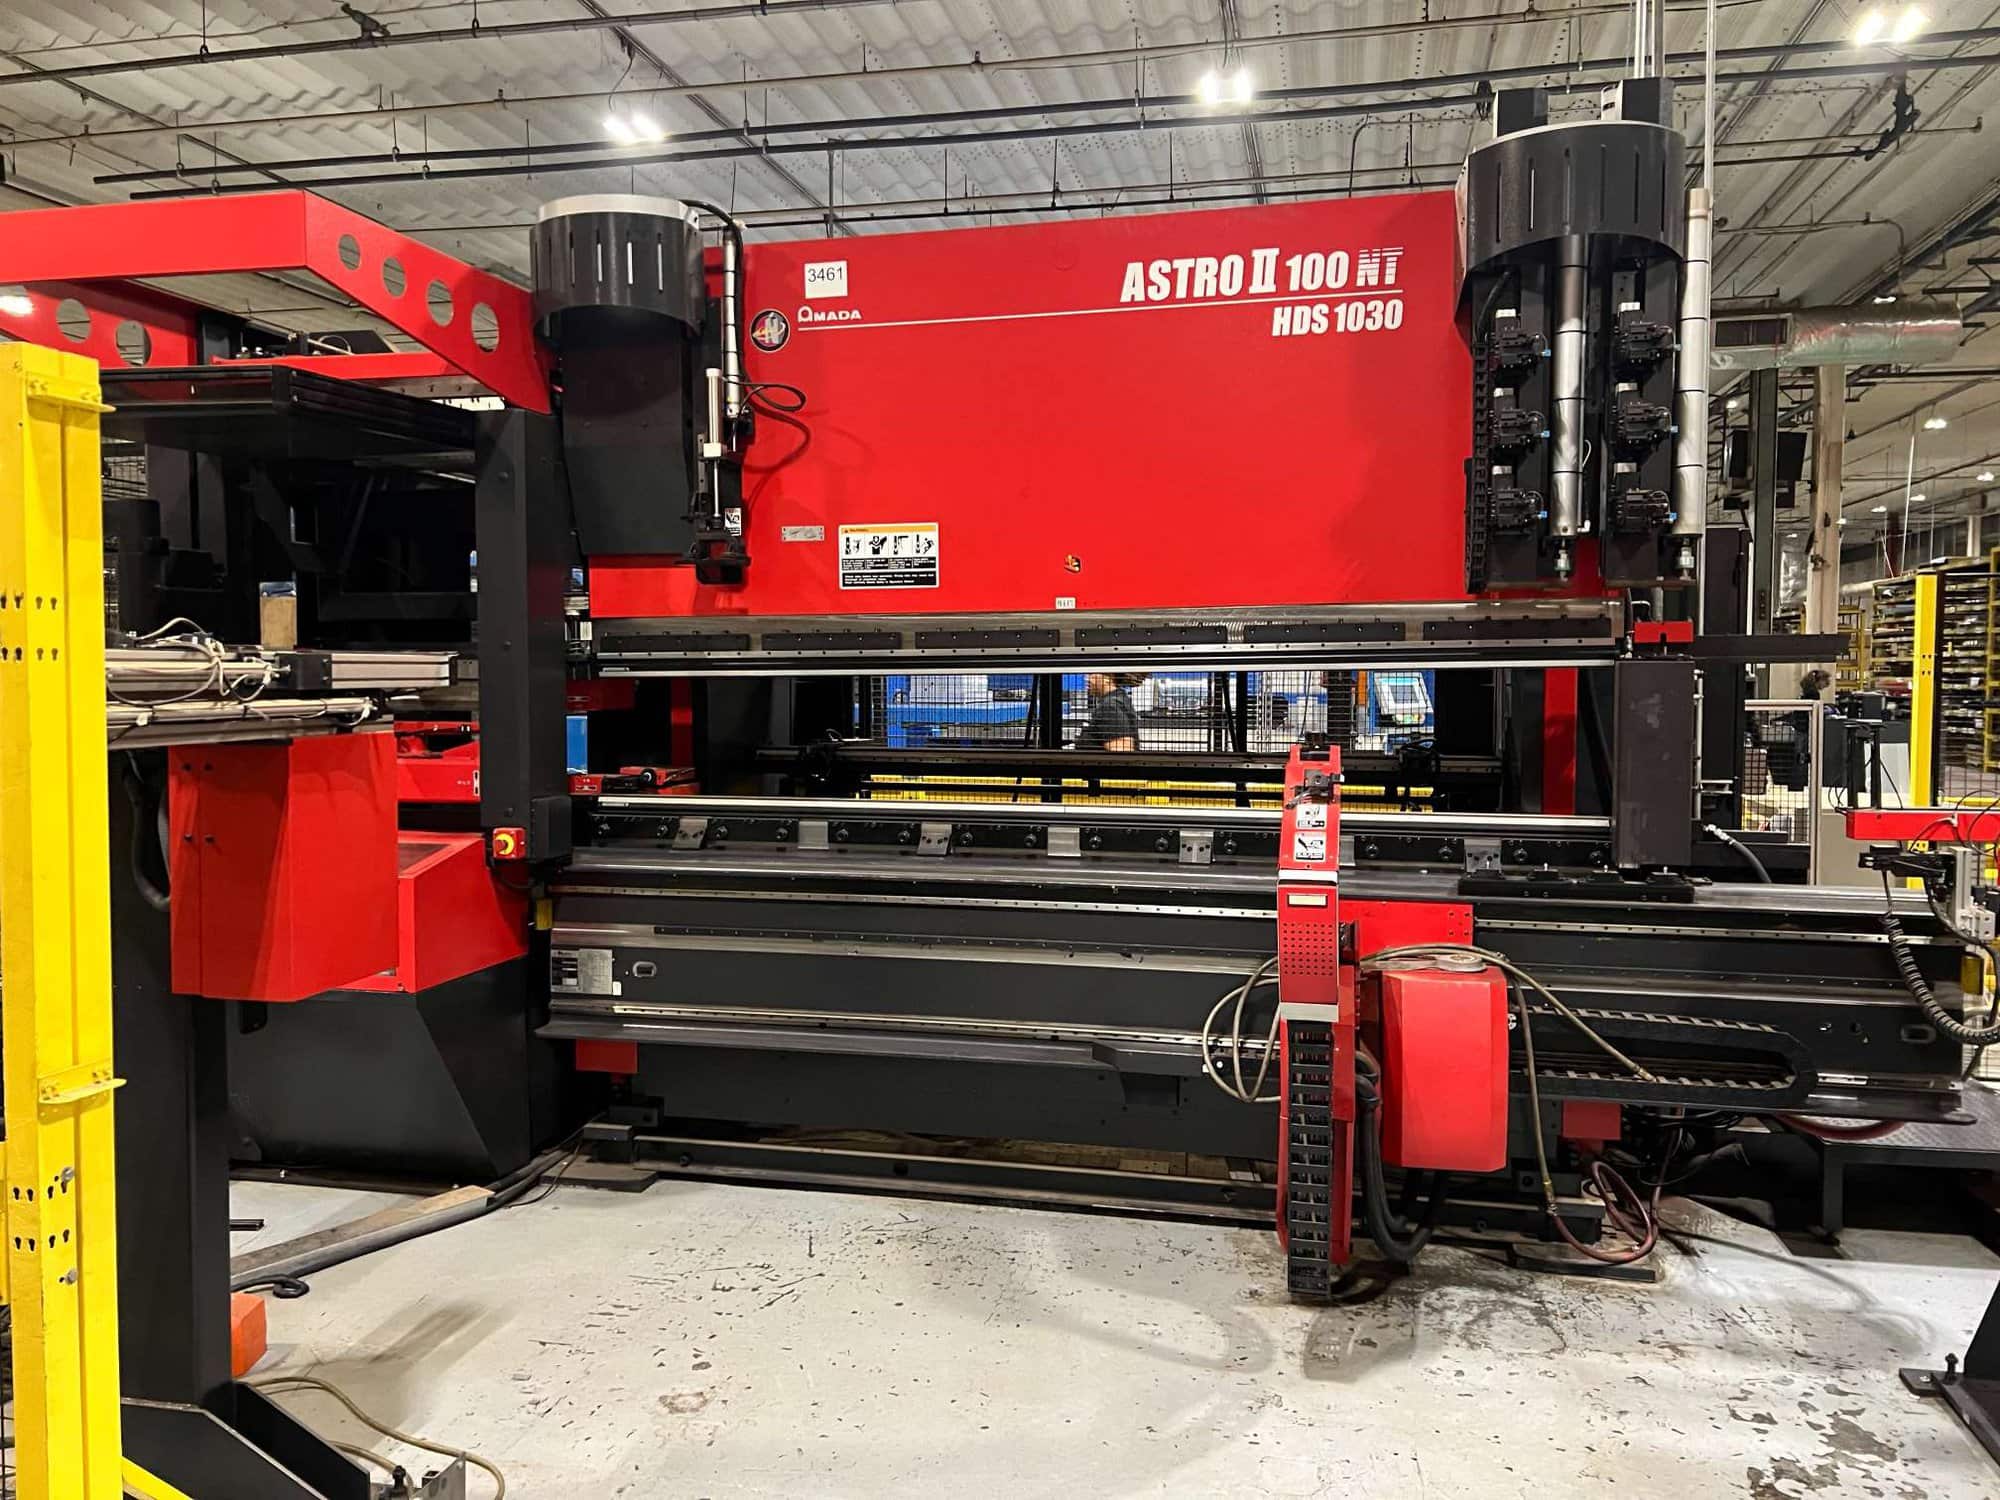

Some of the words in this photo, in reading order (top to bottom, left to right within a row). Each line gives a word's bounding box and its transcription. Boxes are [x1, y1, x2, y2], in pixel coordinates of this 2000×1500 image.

[808, 267, 843, 282] 3461
[1120, 254, 1245, 302] ASTRO
[1286, 251, 1349, 291] 100
[1356, 247, 1404, 286] NT
[798, 306, 862, 322] AMADA
[1272, 303, 1329, 336] HDS
[1334, 299, 1404, 332] 1030
